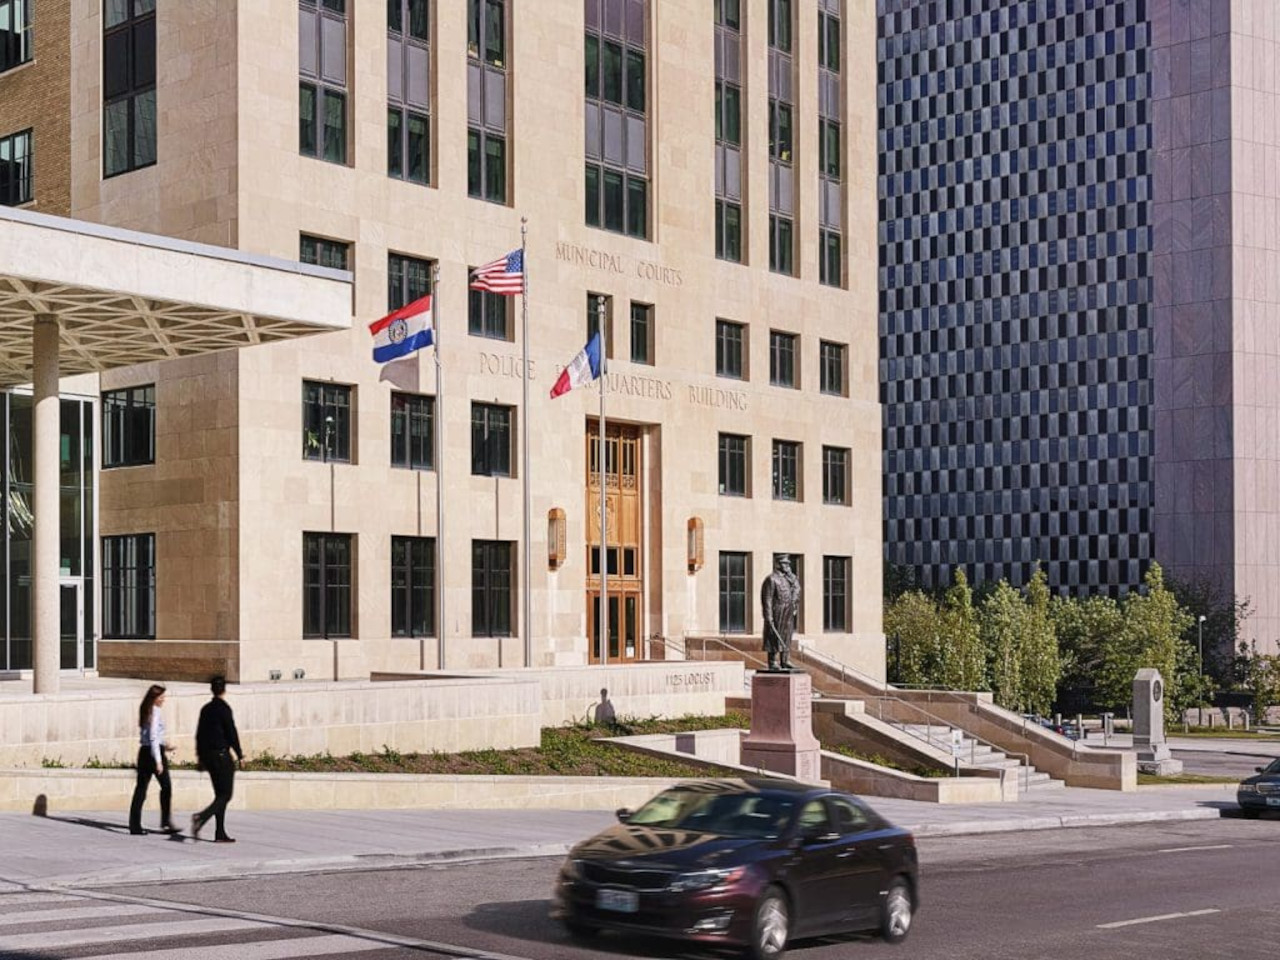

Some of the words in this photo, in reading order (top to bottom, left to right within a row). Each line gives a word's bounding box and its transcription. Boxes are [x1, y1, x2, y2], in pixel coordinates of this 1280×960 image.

[555, 243, 625, 274] MUNICIPAL
[637, 260, 683, 287] COURTS
[479, 352, 536, 381] POLICE
[688, 385, 748, 411] BUILDING
[684, 671, 716, 686] LOCUST
